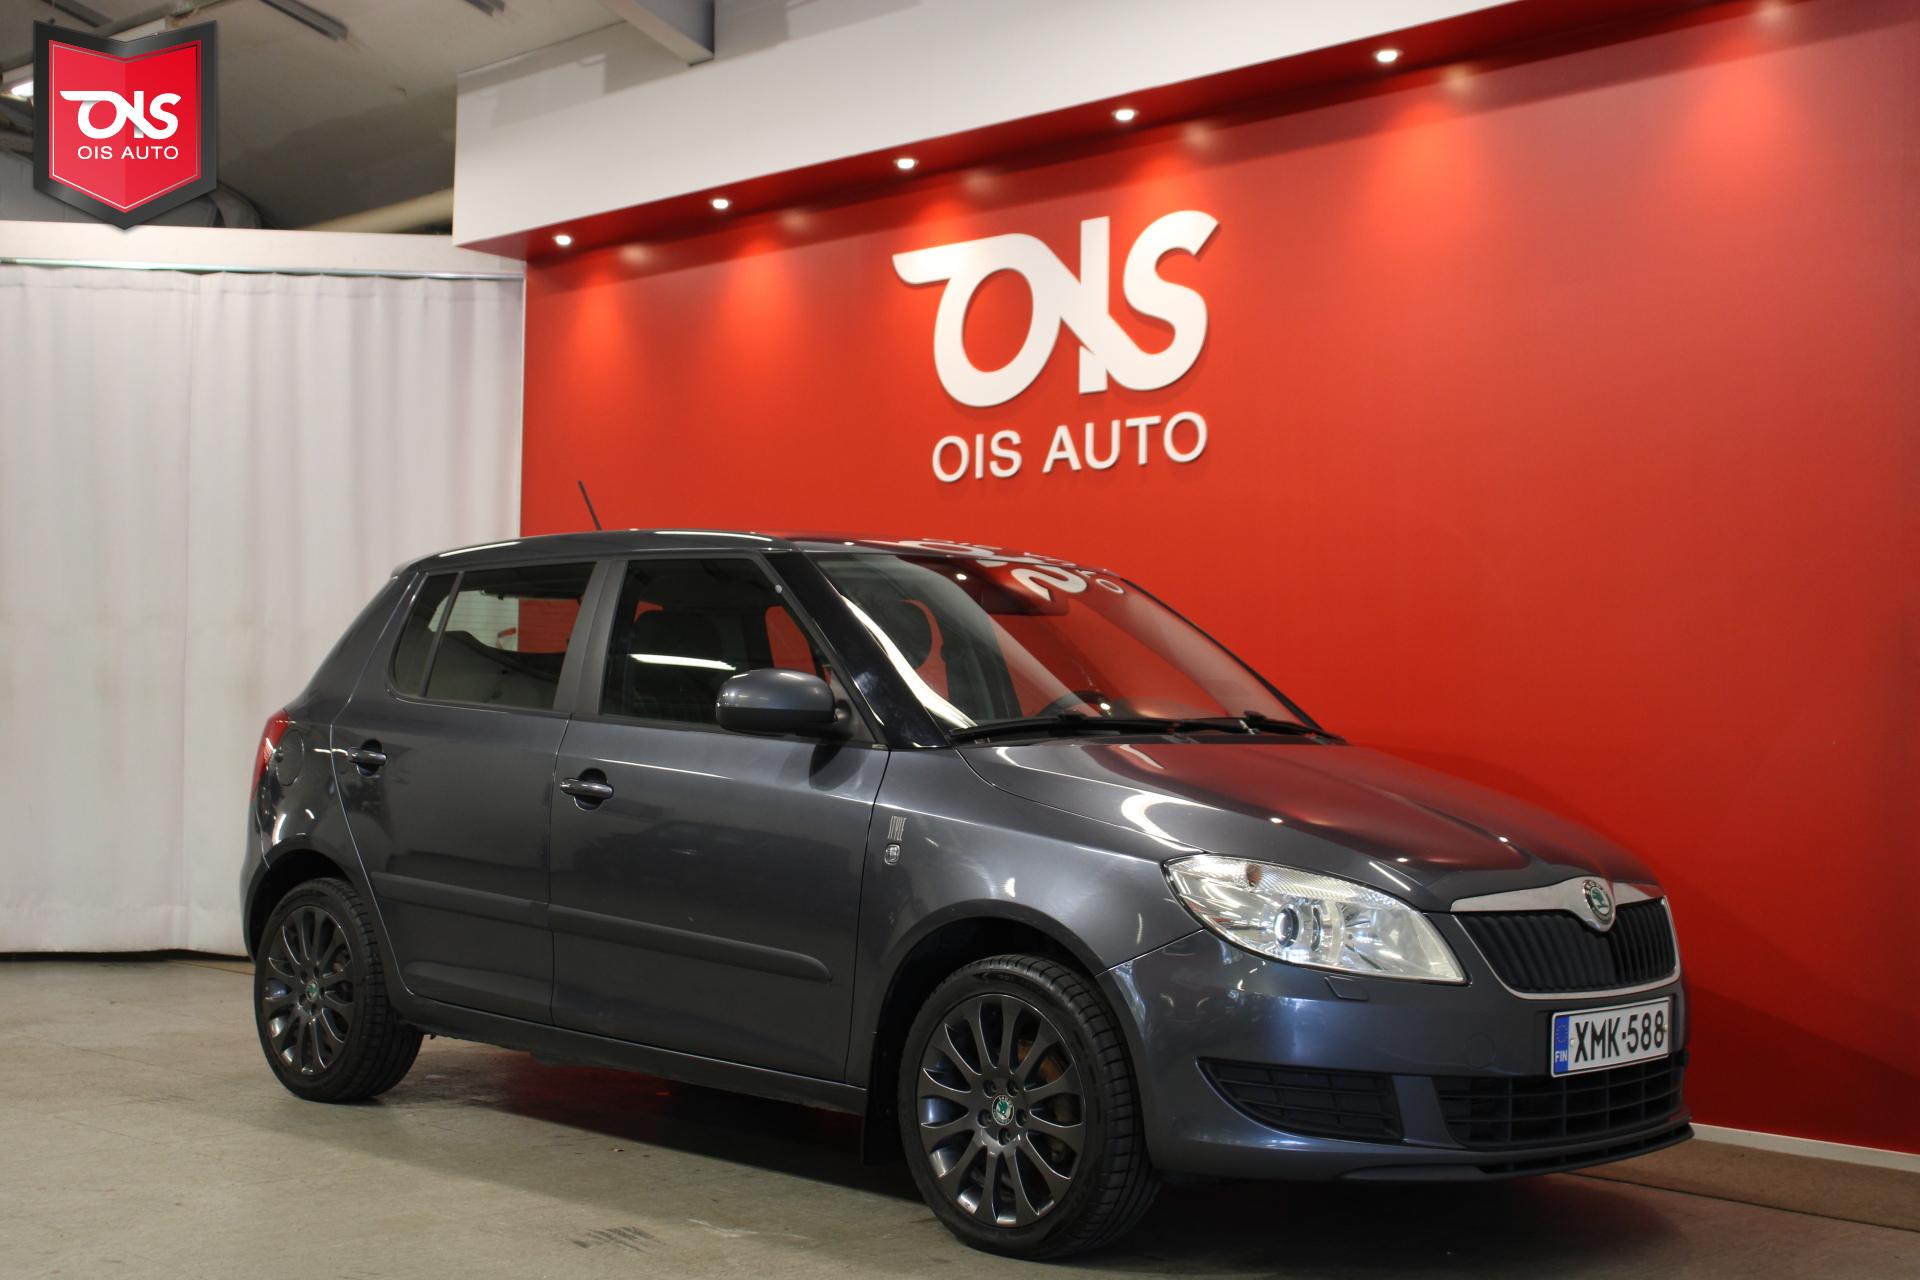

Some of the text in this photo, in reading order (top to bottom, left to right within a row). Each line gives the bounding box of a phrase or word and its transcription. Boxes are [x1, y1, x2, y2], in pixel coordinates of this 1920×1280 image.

[892, 210, 1219, 407] OIS
[932, 411, 1208, 483] OIS AUTO
[1554, 1049, 1569, 1063] FIN
[1574, 1009, 1665, 1063] XMK-588
